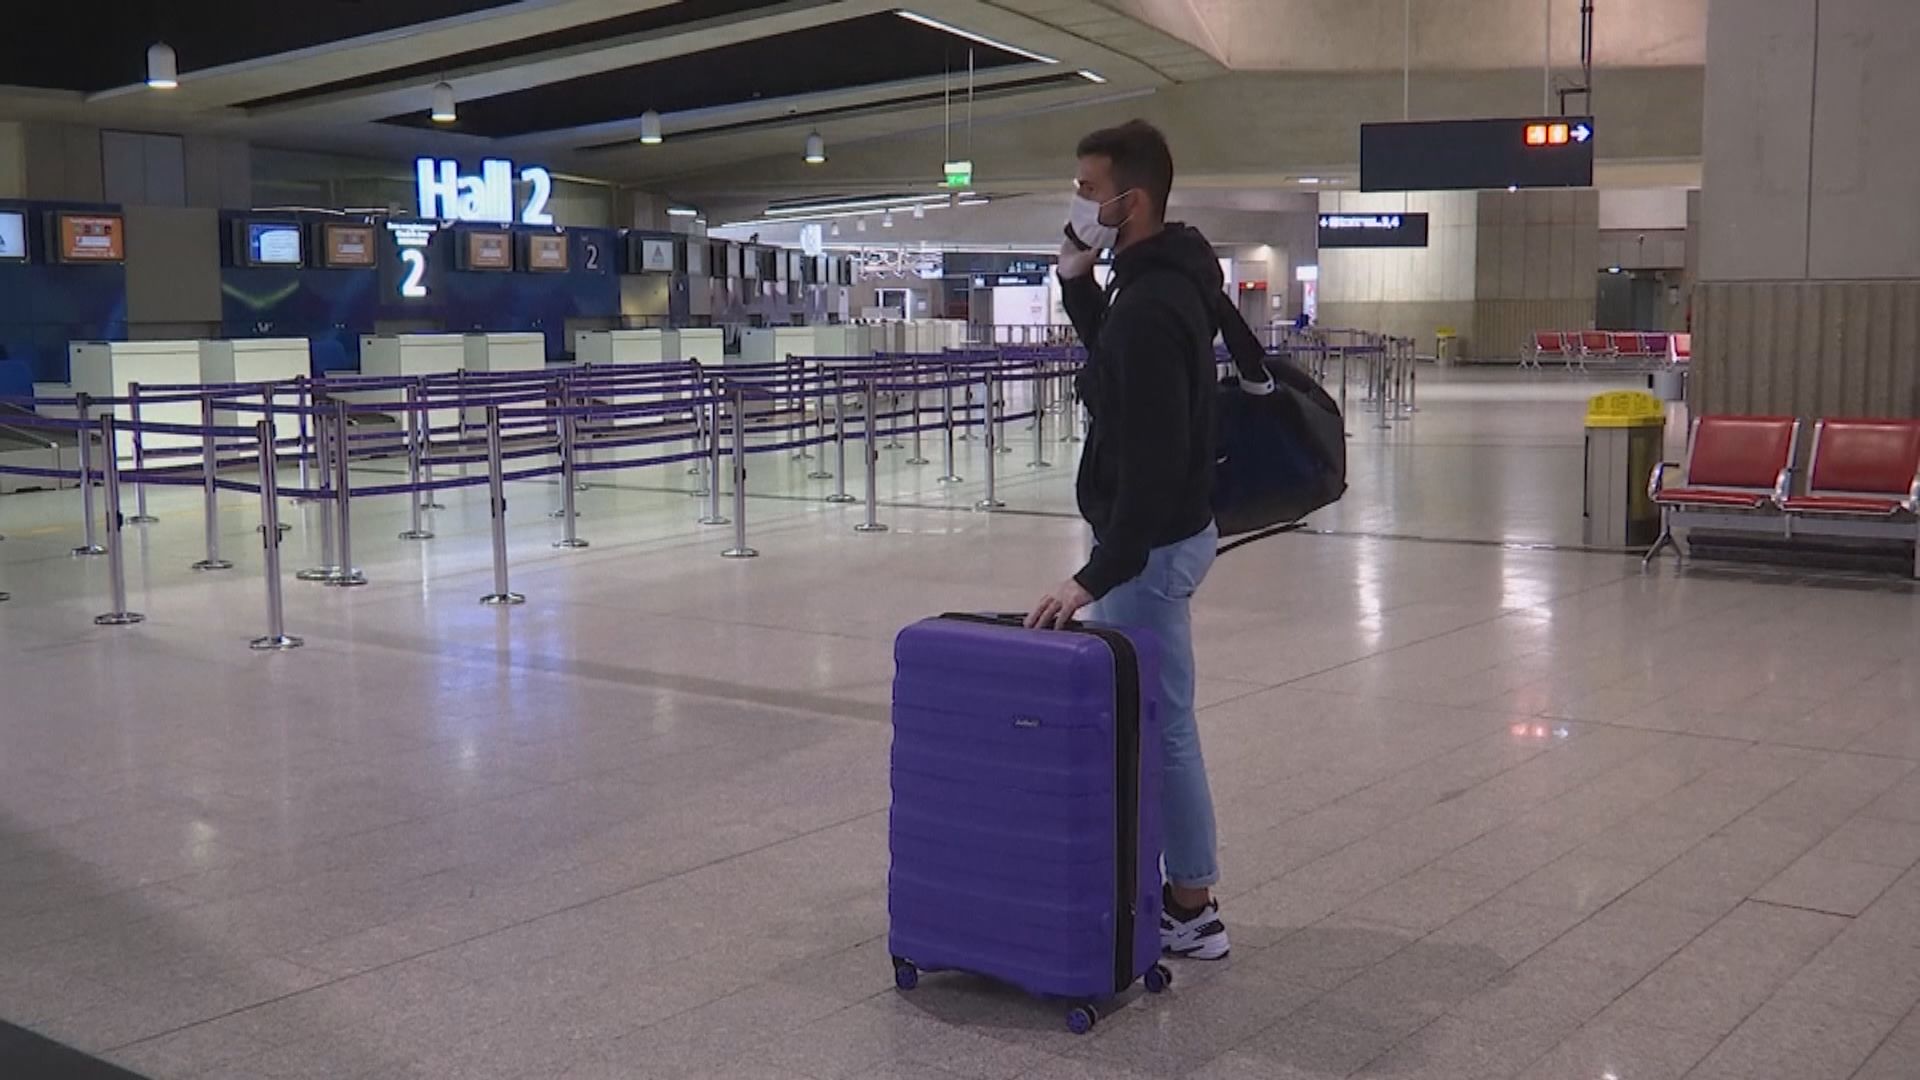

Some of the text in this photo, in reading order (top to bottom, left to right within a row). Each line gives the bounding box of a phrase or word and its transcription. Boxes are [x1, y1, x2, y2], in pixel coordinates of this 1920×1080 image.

[417, 158, 553, 225] Hall 2
[401, 248, 427, 297] 2
[586, 244, 598, 269] 2
